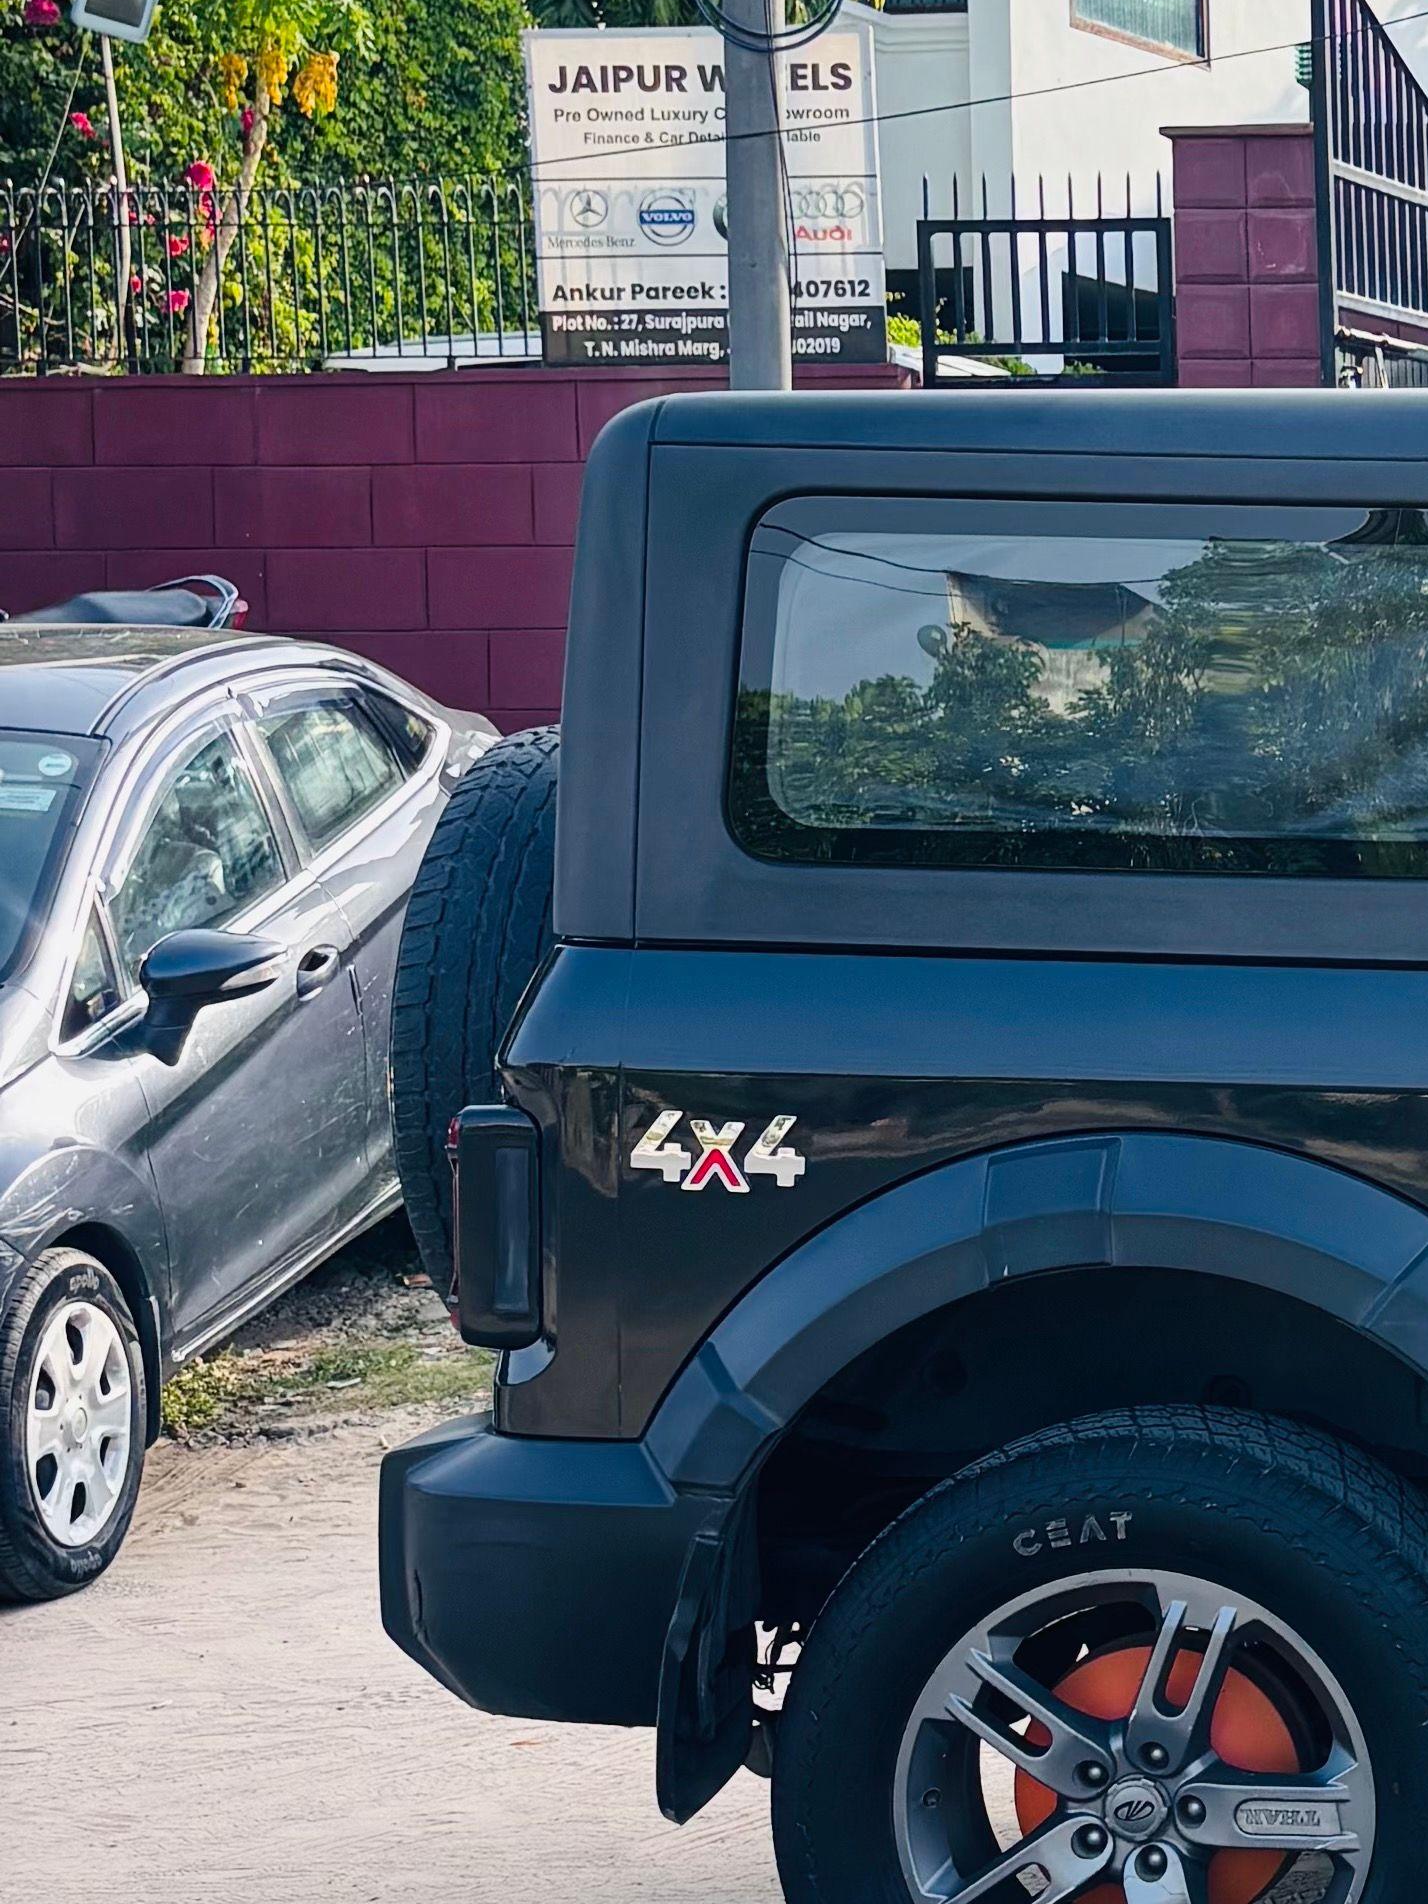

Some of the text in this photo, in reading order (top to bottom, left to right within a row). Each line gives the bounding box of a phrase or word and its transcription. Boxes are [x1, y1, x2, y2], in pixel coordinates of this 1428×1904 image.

[548, 63, 852, 94] JAIPUR WELS
[554, 108, 581, 123] Pre
[587, 108, 645, 122] Owned
[651, 108, 708, 124] Luxury
[584, 132, 640, 145] Finance
[644, 132, 655, 144] &
[659, 132, 684, 144] Car
[641, 211, 694, 223] VOLVO
[796, 225, 852, 241] Audi
[548, 236, 635, 250] Mercedes Benz
[553, 283, 626, 302] Ankur
[631, 282, 716, 301] Pareek
[552, 314, 583, 331] Plot
[645, 312, 725, 335] Surajpura
[817, 311, 872, 332] Nagar,
[620, 339, 675, 357] Mishra
[677, 340, 724, 360] Marg,
[1013, 1511, 1133, 1556] CEAT
[1240, 1808, 1321, 1827] THAR
